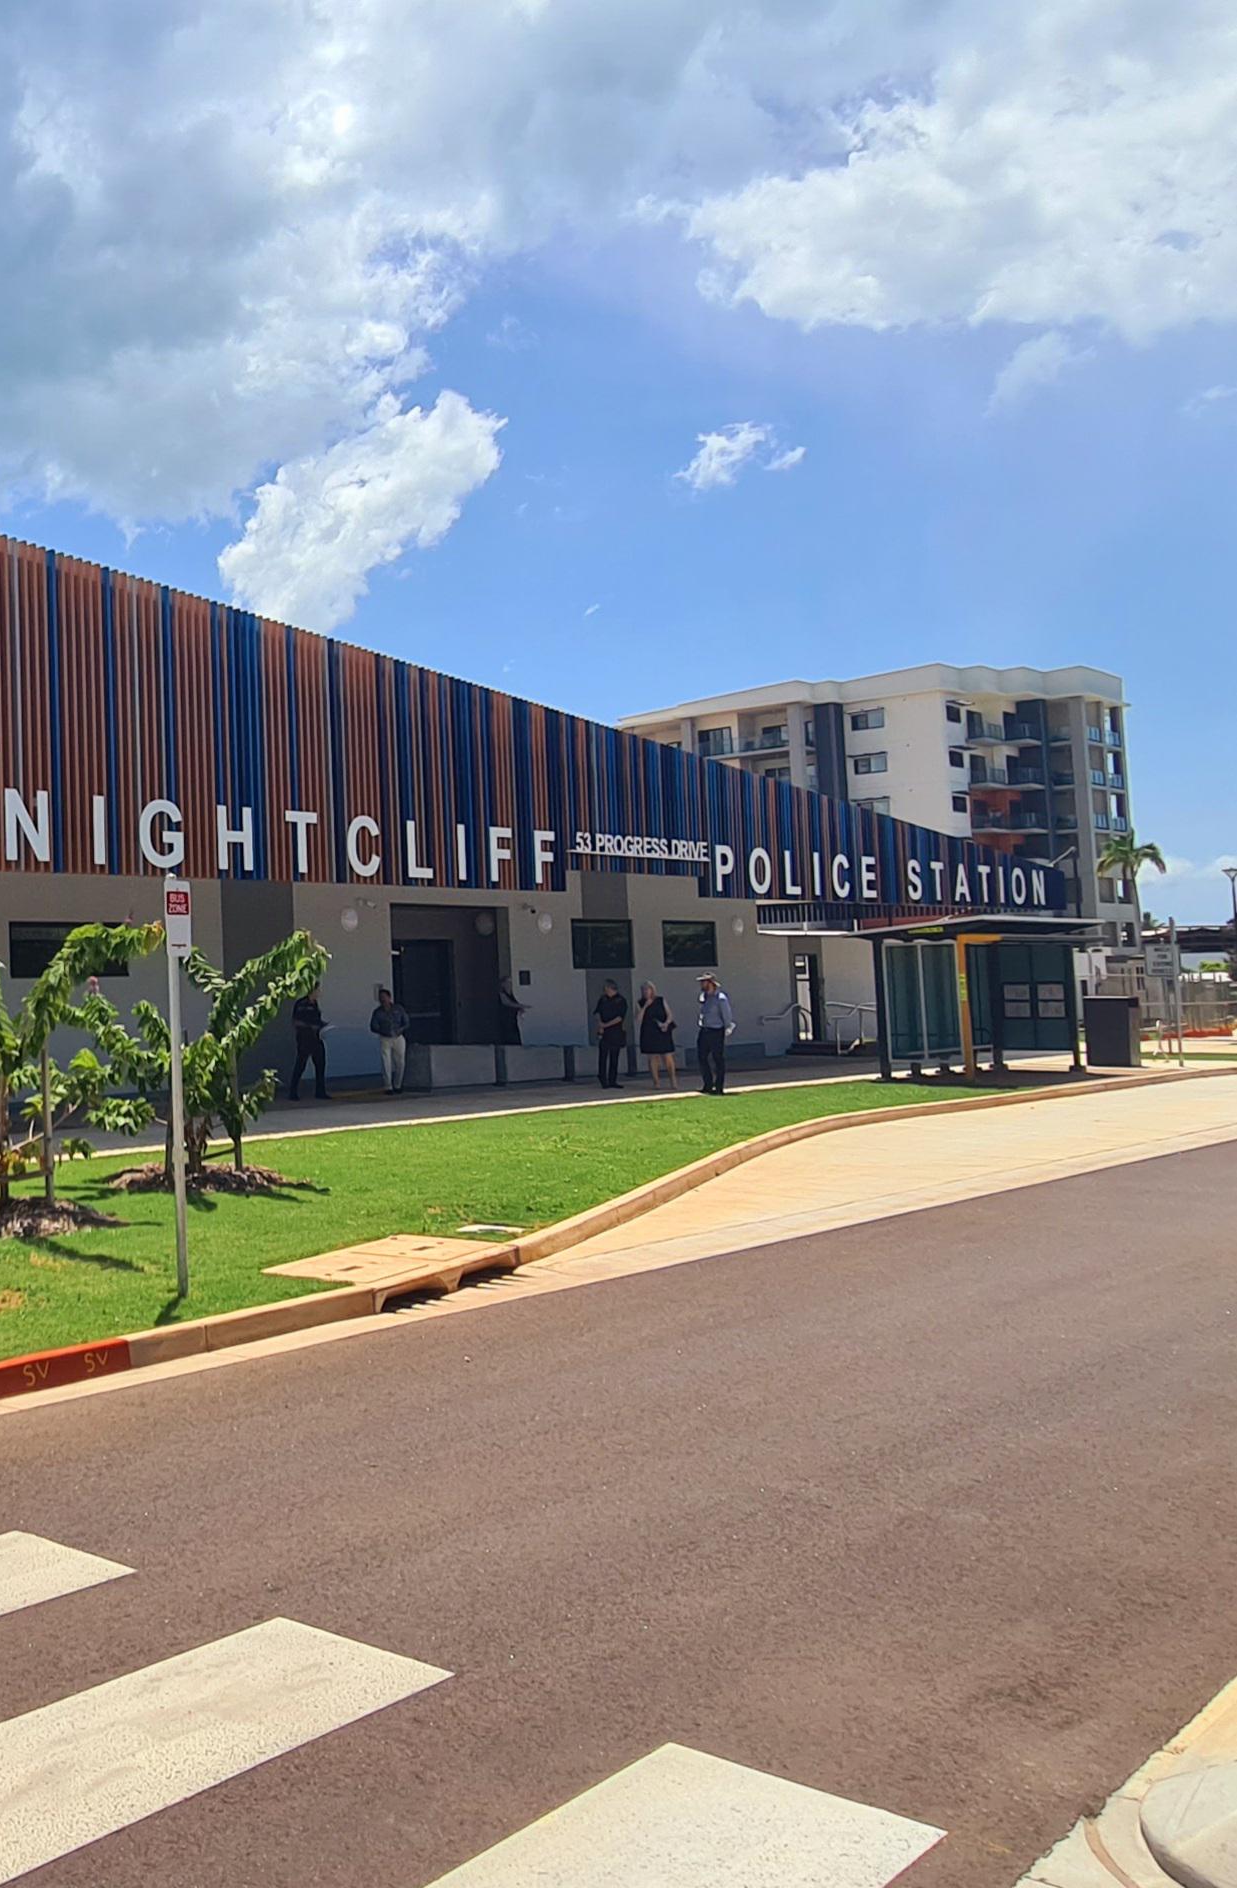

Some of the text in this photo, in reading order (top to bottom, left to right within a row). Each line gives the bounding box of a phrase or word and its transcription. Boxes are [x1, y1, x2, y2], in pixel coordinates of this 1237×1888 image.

[5, 788, 556, 884] NIGHTCLIFF
[576, 831, 708, 859] 53 PROGRESS DRIVE
[715, 844, 1046, 905] POLICE STATION
[168, 903, 187, 913] ZONE
[169, 893, 185, 903] BUS
[23, 1351, 108, 1386] SV SV
